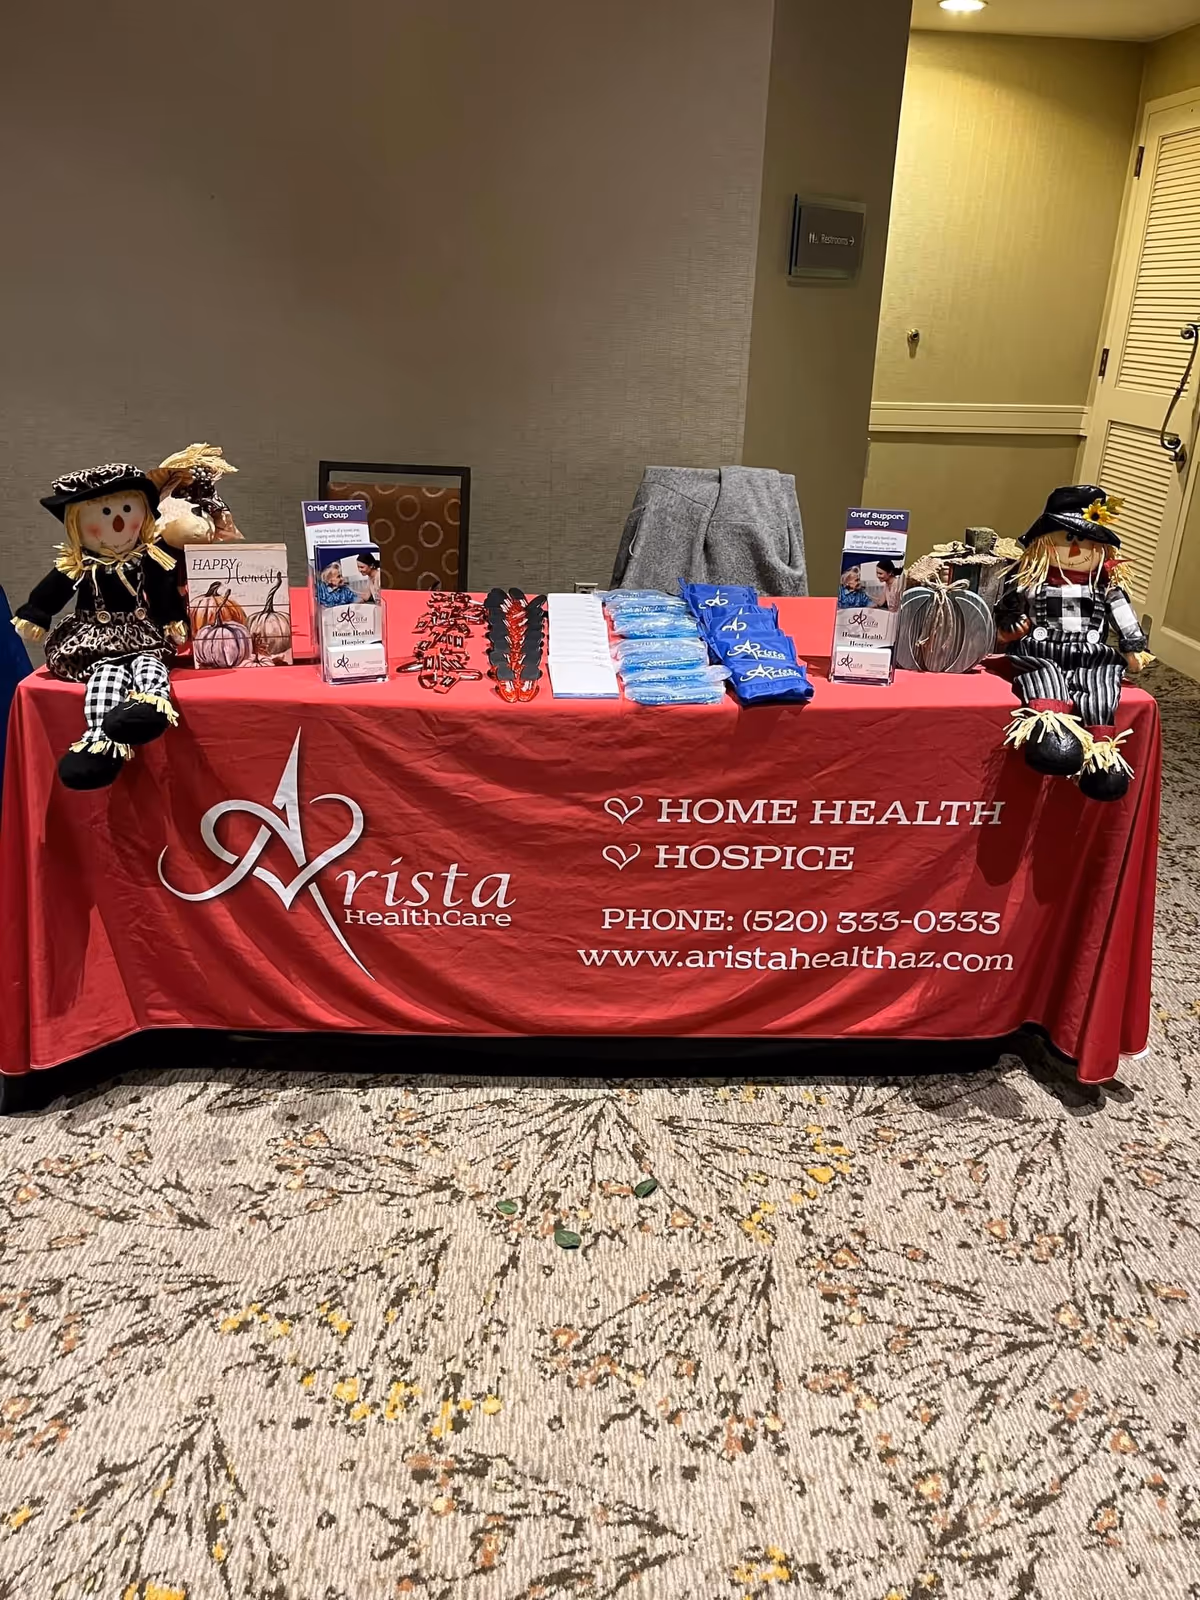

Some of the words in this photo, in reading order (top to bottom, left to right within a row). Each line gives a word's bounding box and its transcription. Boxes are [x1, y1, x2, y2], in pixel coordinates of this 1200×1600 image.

[821, 234, 848, 246] Restrooms
[192, 558, 237, 571] HAPPY
[225, 561, 275, 585] Harvest
[332, 630, 351, 638] Home
[352, 629, 375, 637] Health
[842, 631, 861, 640] Home
[861, 633, 883, 641] Health
[727, 639, 787, 661] Arista
[656, 798, 799, 826] HOME
[809, 798, 1006, 827] HEALTH
[157, 726, 517, 980] Arista
[654, 844, 856, 872] HOSPICE
[344, 908, 512, 928] HealthCare
[601, 908, 735, 933] PHONE:
[743, 909, 828, 934] (520)
[836, 909, 1002, 936] 333-0333
[577, 944, 1014, 973] www.aristahealthaz.com
